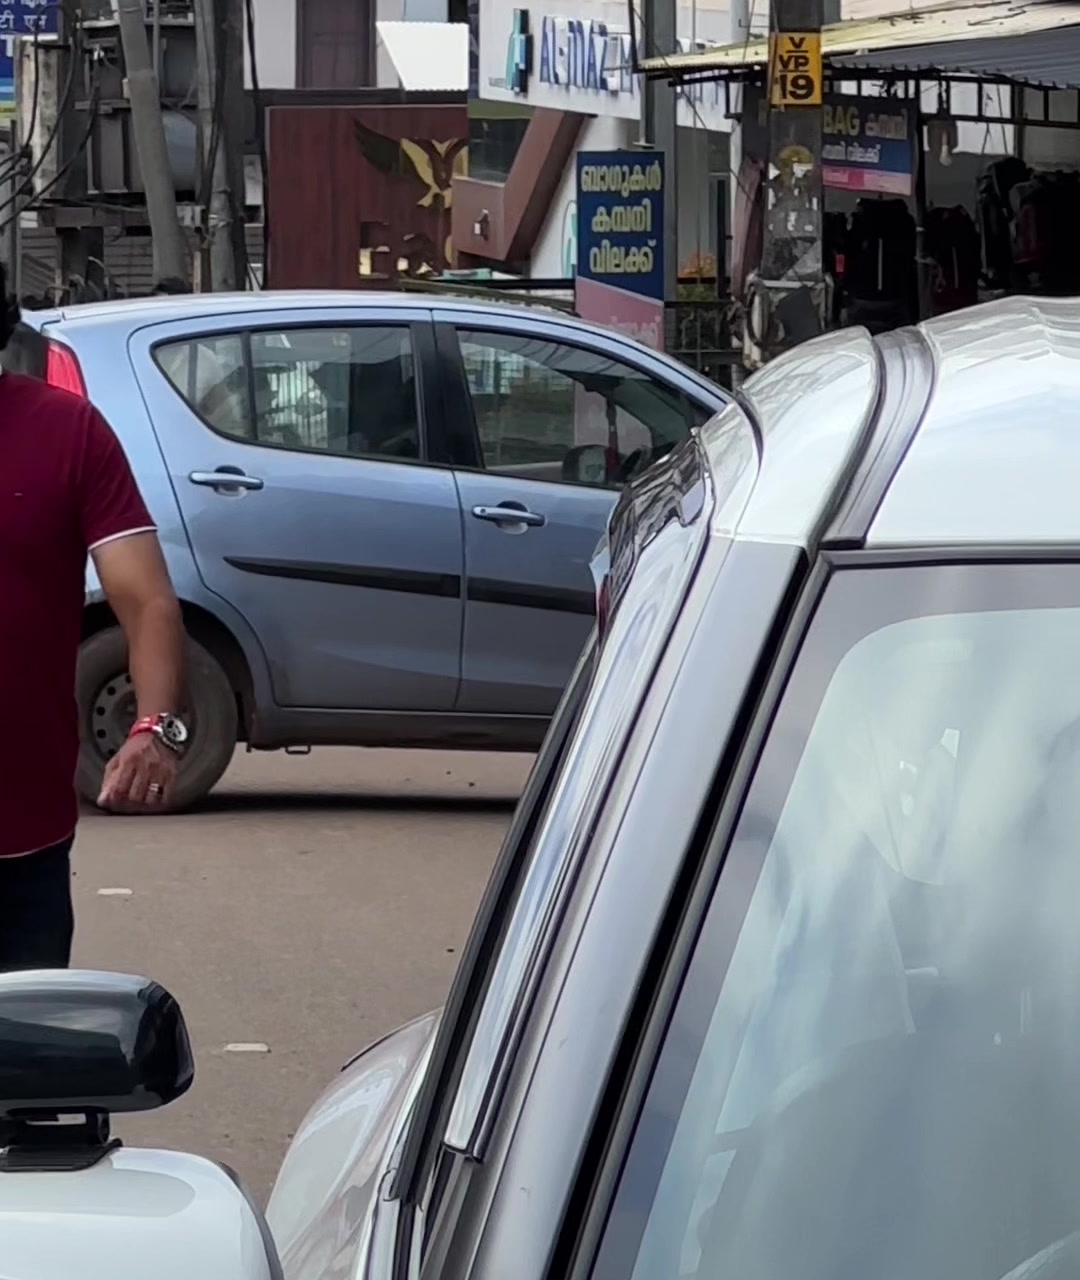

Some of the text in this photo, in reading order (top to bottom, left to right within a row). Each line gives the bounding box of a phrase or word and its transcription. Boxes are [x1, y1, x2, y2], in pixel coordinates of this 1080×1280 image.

[779, 55, 810, 70] VP
[779, 74, 815, 100] 19
[823, 104, 860, 136] BAG
